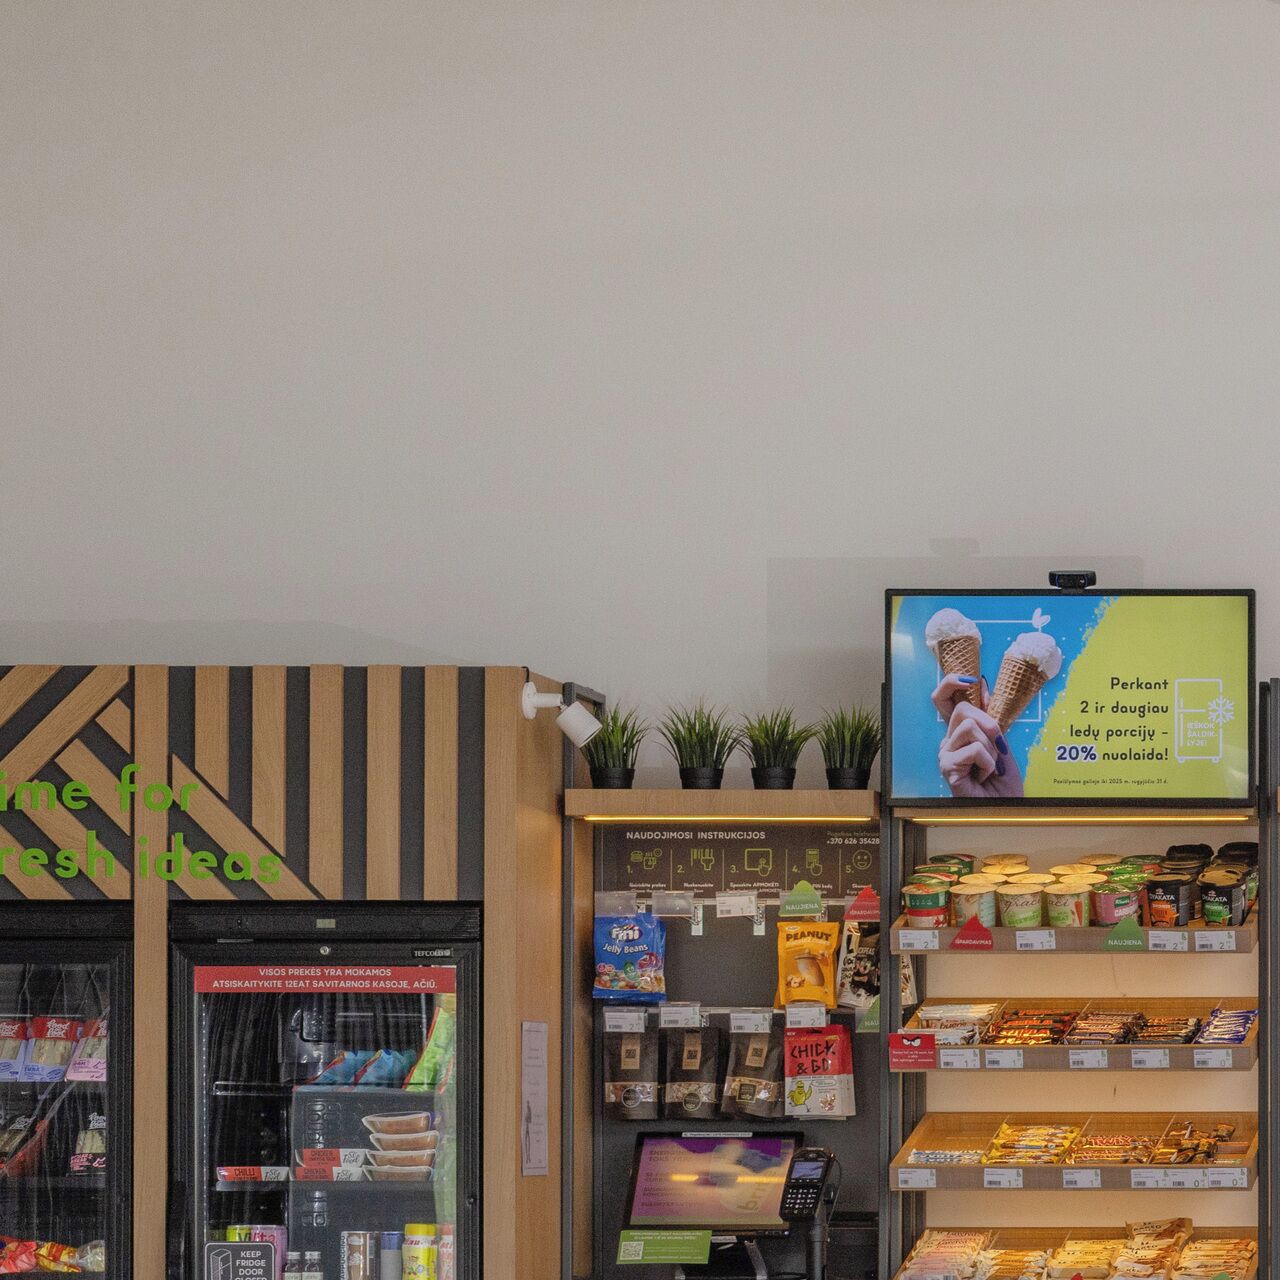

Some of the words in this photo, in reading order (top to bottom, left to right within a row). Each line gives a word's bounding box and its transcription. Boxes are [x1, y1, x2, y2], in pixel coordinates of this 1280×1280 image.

[1111, 677, 1168, 690] Perkant
[1080, 701, 1089, 713] 2
[1096, 701, 1105, 713] ir
[1111, 701, 1168, 718] daugiau
[1070, 725, 1099, 741] ledų
[1106, 725, 1155, 742] porcijų
[1056, 745, 1097, 761] 20%
[1103, 748, 1168, 761] nuolaida!
[116, 763, 200, 812] for
[626, 831, 693, 840] NAUDOJIMOSI
[698, 831, 766, 840] INSTRUKCIJOS
[139, 832, 283, 883] ideas
[627, 865, 633, 873] 1.
[677, 865, 685, 873] 2.
[730, 865, 739, 873] 3.
[846, 865, 854, 873] 5.
[786, 930, 832, 942] PEANUT
[603, 943, 621, 955] Jelly
[624, 944, 649, 953] Beans
[288, 967, 322, 976] PREKĖS
[213, 980, 283, 988] ATSISKAITYKITE
[285, 980, 310, 988] 12EAT
[312, 980, 370, 988] SAVITARNOS
[372, 980, 411, 989] KASOJE,
[791, 1040, 836, 1058] CHICK
[796, 1062, 808, 1074] &
[236, 1259, 266, 1267] FRIDGE
